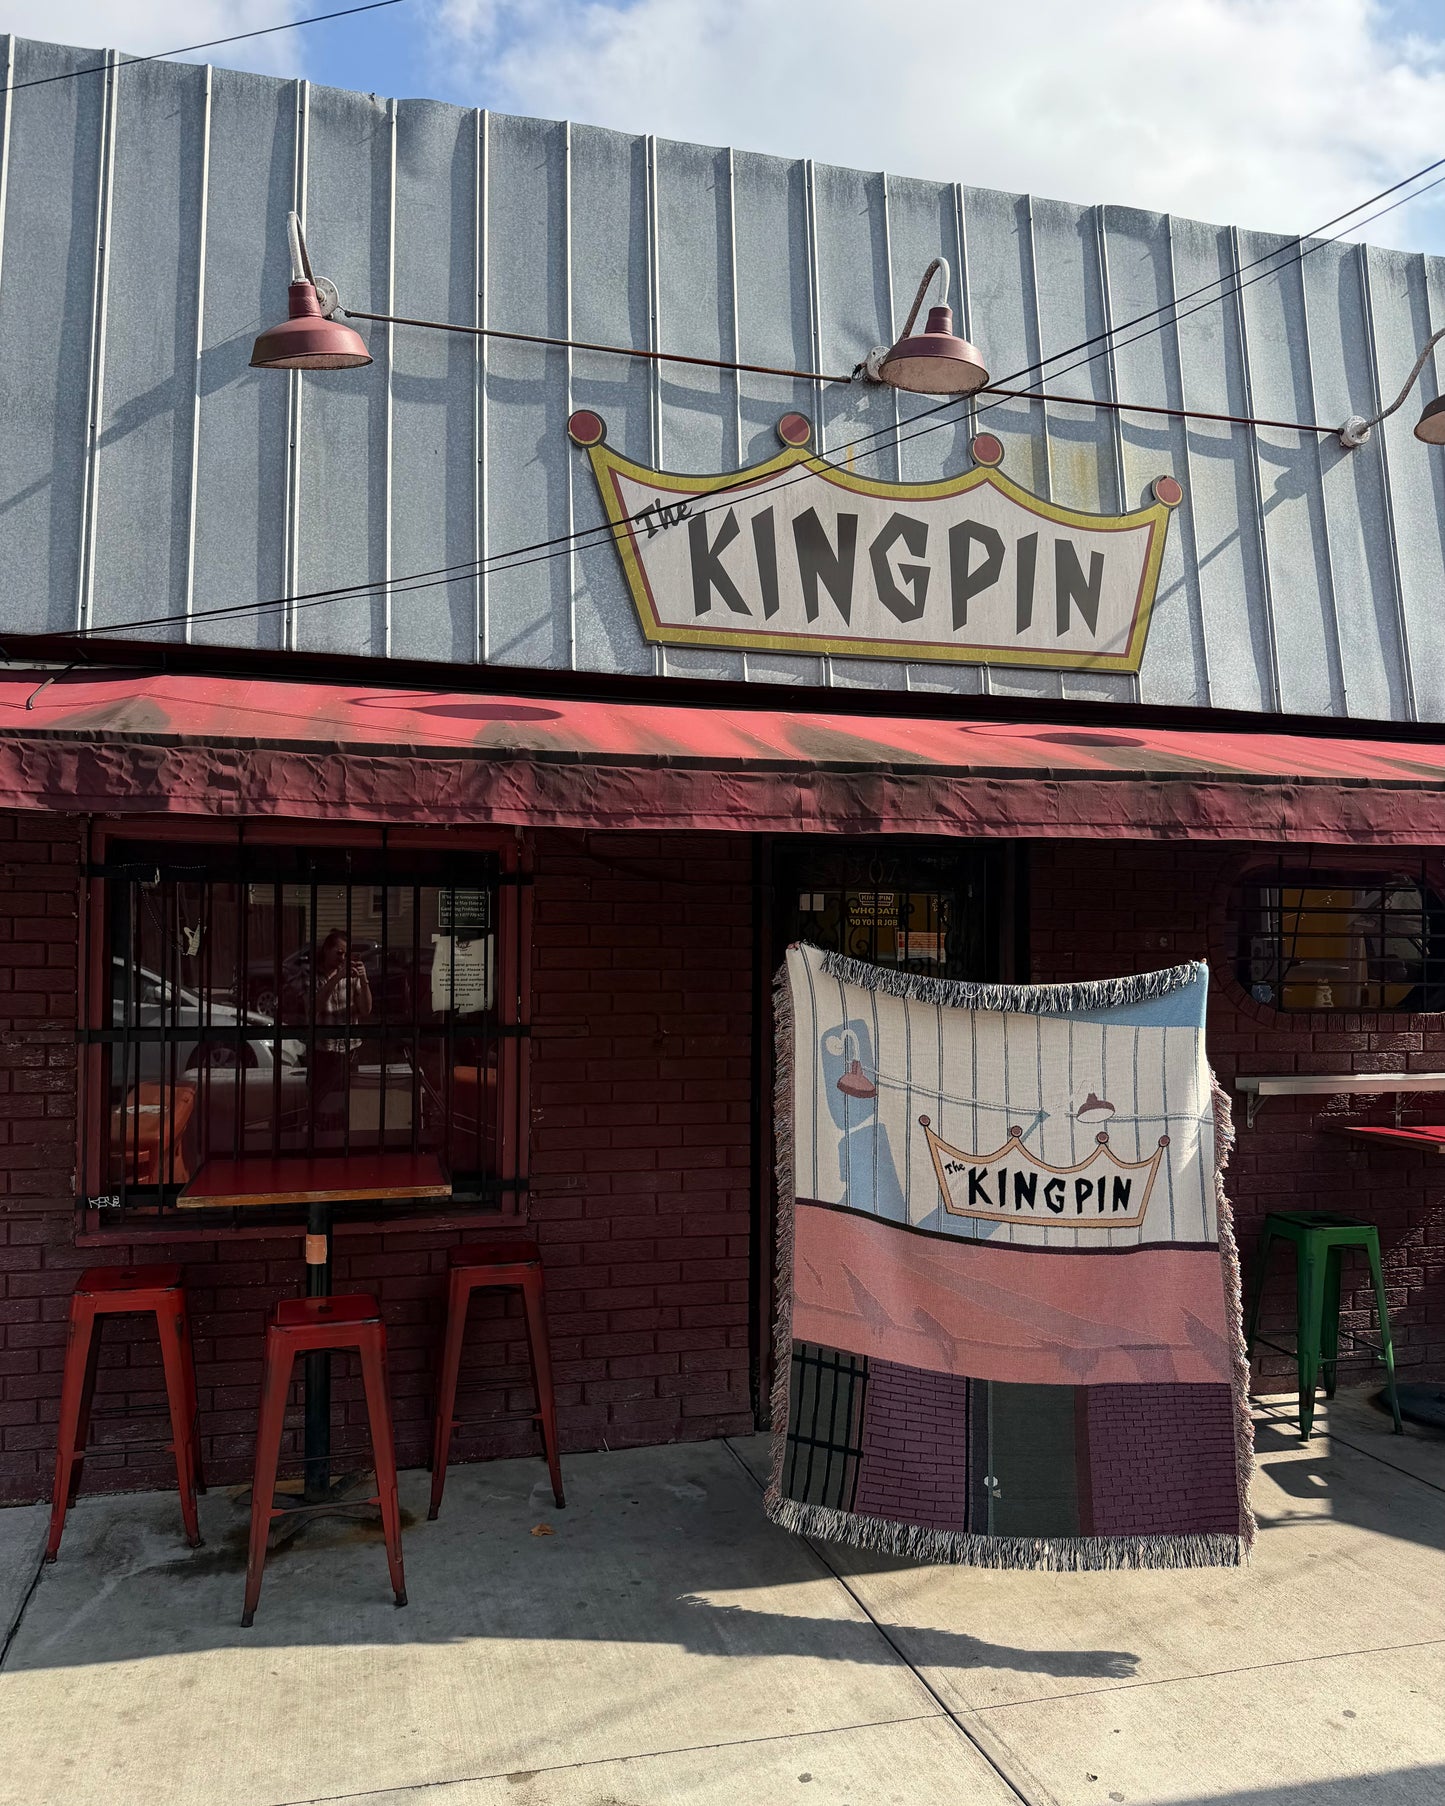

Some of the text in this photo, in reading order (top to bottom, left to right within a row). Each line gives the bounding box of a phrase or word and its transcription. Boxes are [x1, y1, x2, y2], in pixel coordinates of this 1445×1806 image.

[635, 500, 693, 538] The
[687, 504, 1105, 638] KINGPIN
[944, 1161, 966, 1175] The
[968, 1166, 1132, 1215] KINGPIN
